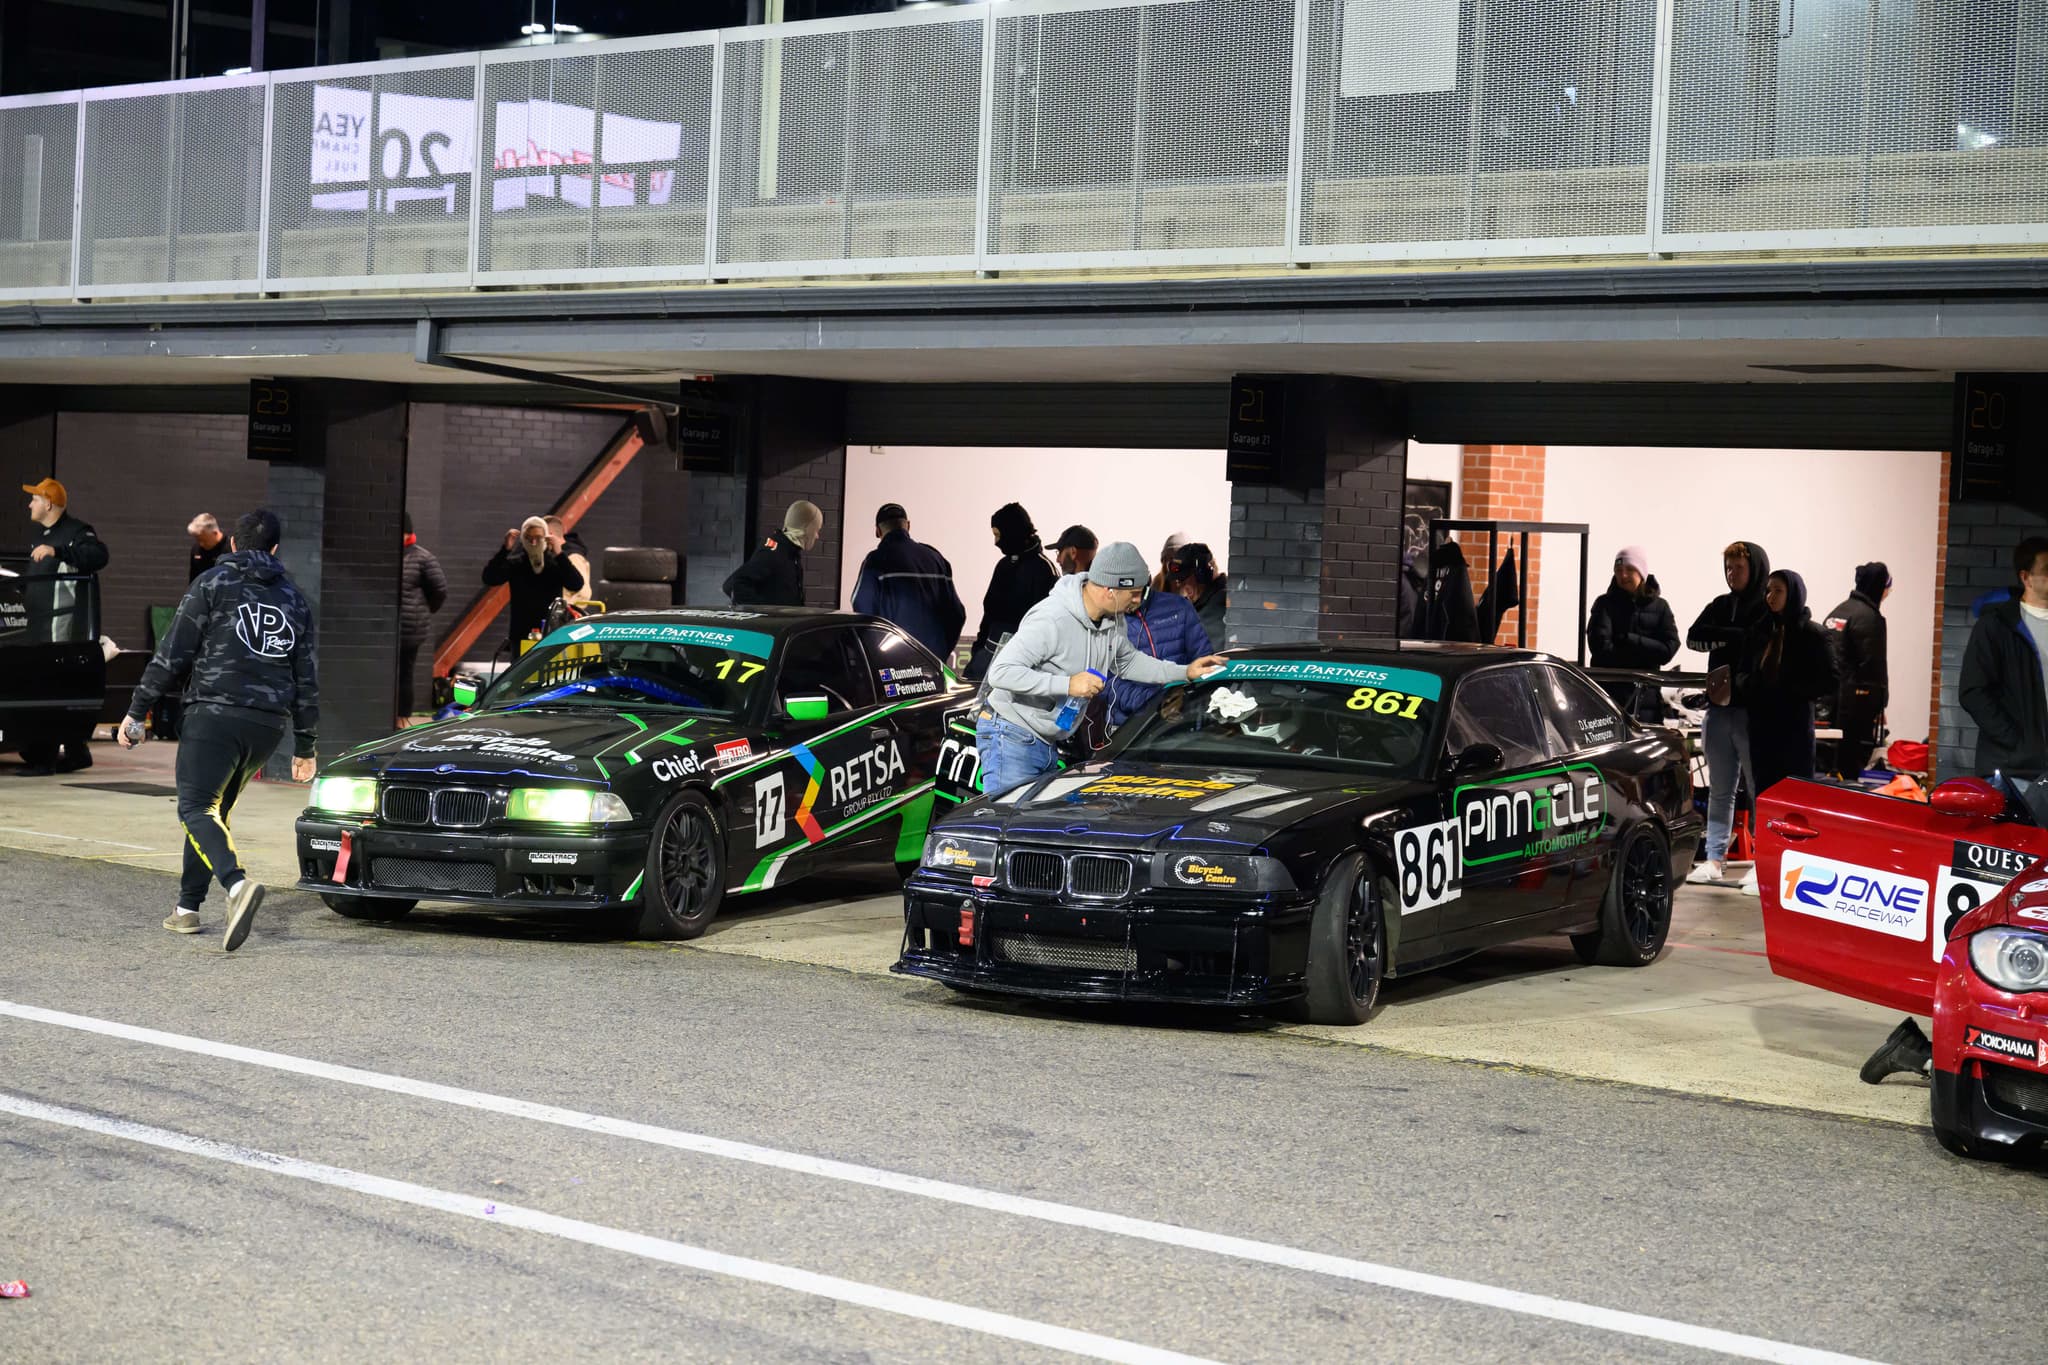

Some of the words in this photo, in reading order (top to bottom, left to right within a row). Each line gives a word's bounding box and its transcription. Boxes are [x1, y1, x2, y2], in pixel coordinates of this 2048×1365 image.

[256, 387, 289, 415] 23
[1239, 388, 1265, 422] 21
[253, 421, 280, 433] Garage
[682, 426, 709, 441] Garage
[1233, 432, 1260, 446] Garage
[238, 602, 286, 654] VP
[598, 626, 658, 635] PITCHER
[659, 627, 735, 643] PARTNERS
[714, 658, 766, 684] 17
[890, 665, 923, 681] Rummler
[1231, 663, 1300, 673] PITCHER
[1301, 664, 1389, 681] PARTNERS
[895, 680, 937, 696] Penwarden
[1345, 687, 1425, 720] 861
[441, 734, 551, 746] Bicycle
[478, 743, 577, 762] Centre
[652, 749, 704, 781] Chief
[830, 739, 906, 807] RETSA
[1080, 784, 1206, 798] Centre
[1094, 775, 1236, 790] Bicycle
[757, 785, 783, 836] 17
[843, 797, 867, 818] GROUP
[1523, 830, 1588, 858] AUTOMOTIVE
[1188, 864, 1224, 876] Bicycle
[1400, 823, 1463, 908] 861
[1205, 874, 1237, 884] Centre
[1840, 875, 1925, 914] ONE
[1833, 900, 1914, 928] RACEWAY
[1980, 1032, 2036, 1058] YOKOHAMA
